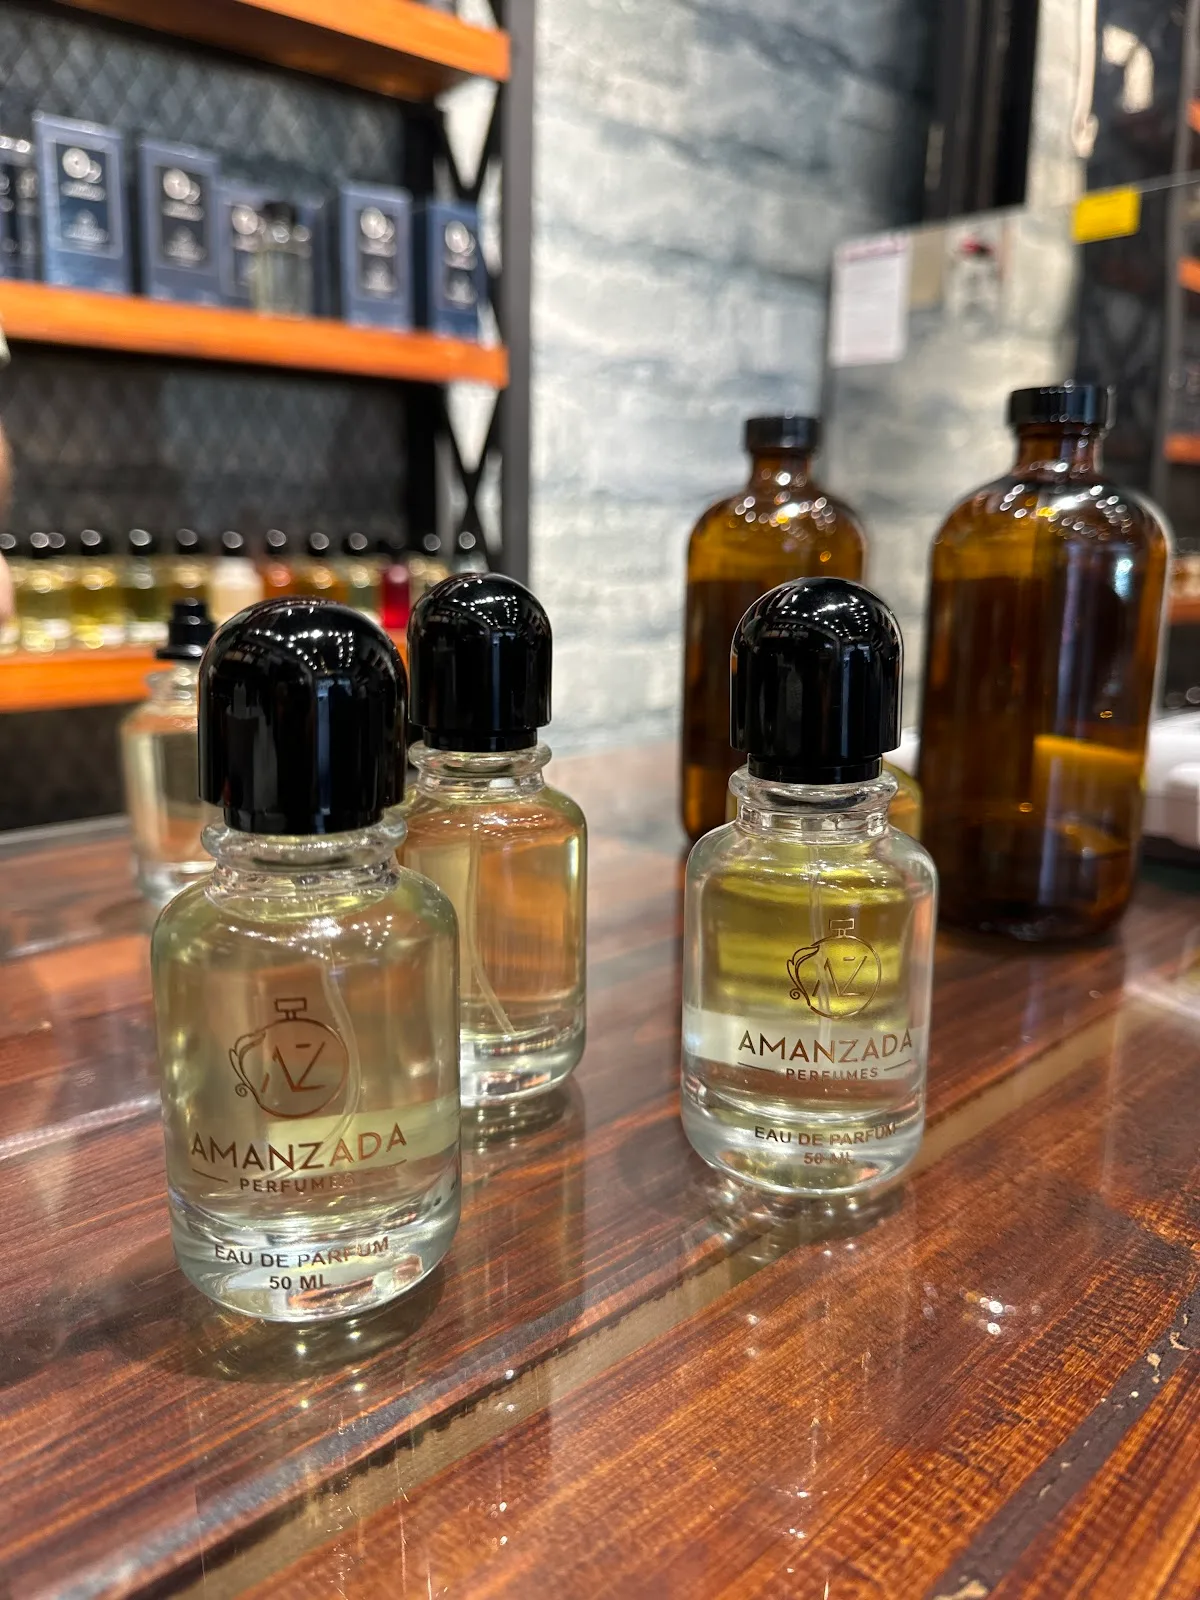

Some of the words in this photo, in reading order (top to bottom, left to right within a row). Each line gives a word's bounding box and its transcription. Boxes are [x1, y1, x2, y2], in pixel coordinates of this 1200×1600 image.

[738, 1028, 912, 1064] AMANZADA
[786, 1067, 878, 1081] PERFUMES
[755, 1126, 791, 1144] EAU
[799, 1133, 824, 1145] DE
[830, 1124, 896, 1145] PARFUM
[191, 1122, 407, 1171] AMANZADA
[240, 1174, 355, 1193] PERFUMES
[215, 1243, 252, 1265] EAU
[261, 1253, 289, 1268] DE
[298, 1236, 389, 1267] PARFUM
[269, 1276, 292, 1290] 50
[300, 1274, 330, 1290] ML
